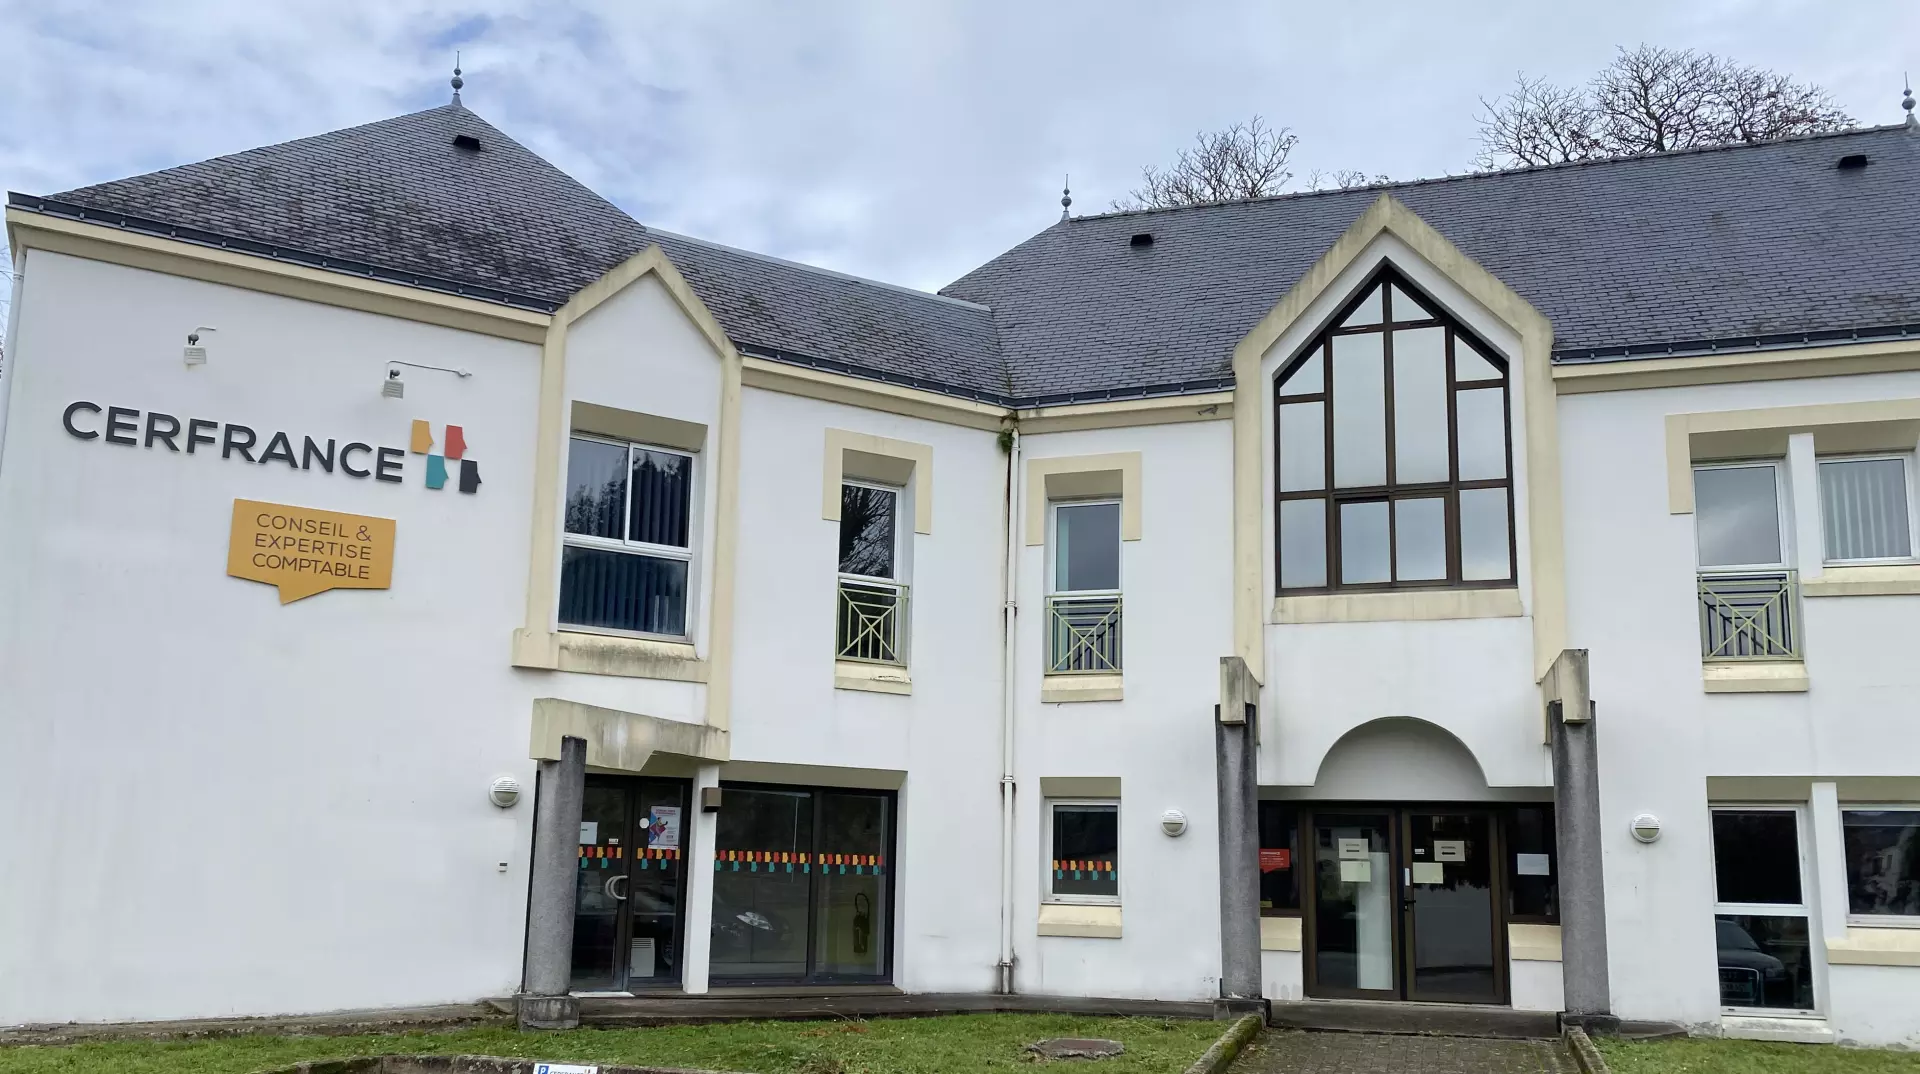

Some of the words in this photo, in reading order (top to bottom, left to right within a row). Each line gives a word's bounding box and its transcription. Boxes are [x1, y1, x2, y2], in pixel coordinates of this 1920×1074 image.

[63, 401, 405, 483] CERFRANCE
[256, 513, 349, 538] CONSEIL
[356, 525, 372, 542] &
[255, 533, 371, 560] EXPERTISE
[252, 553, 370, 579] COMPTABLE
